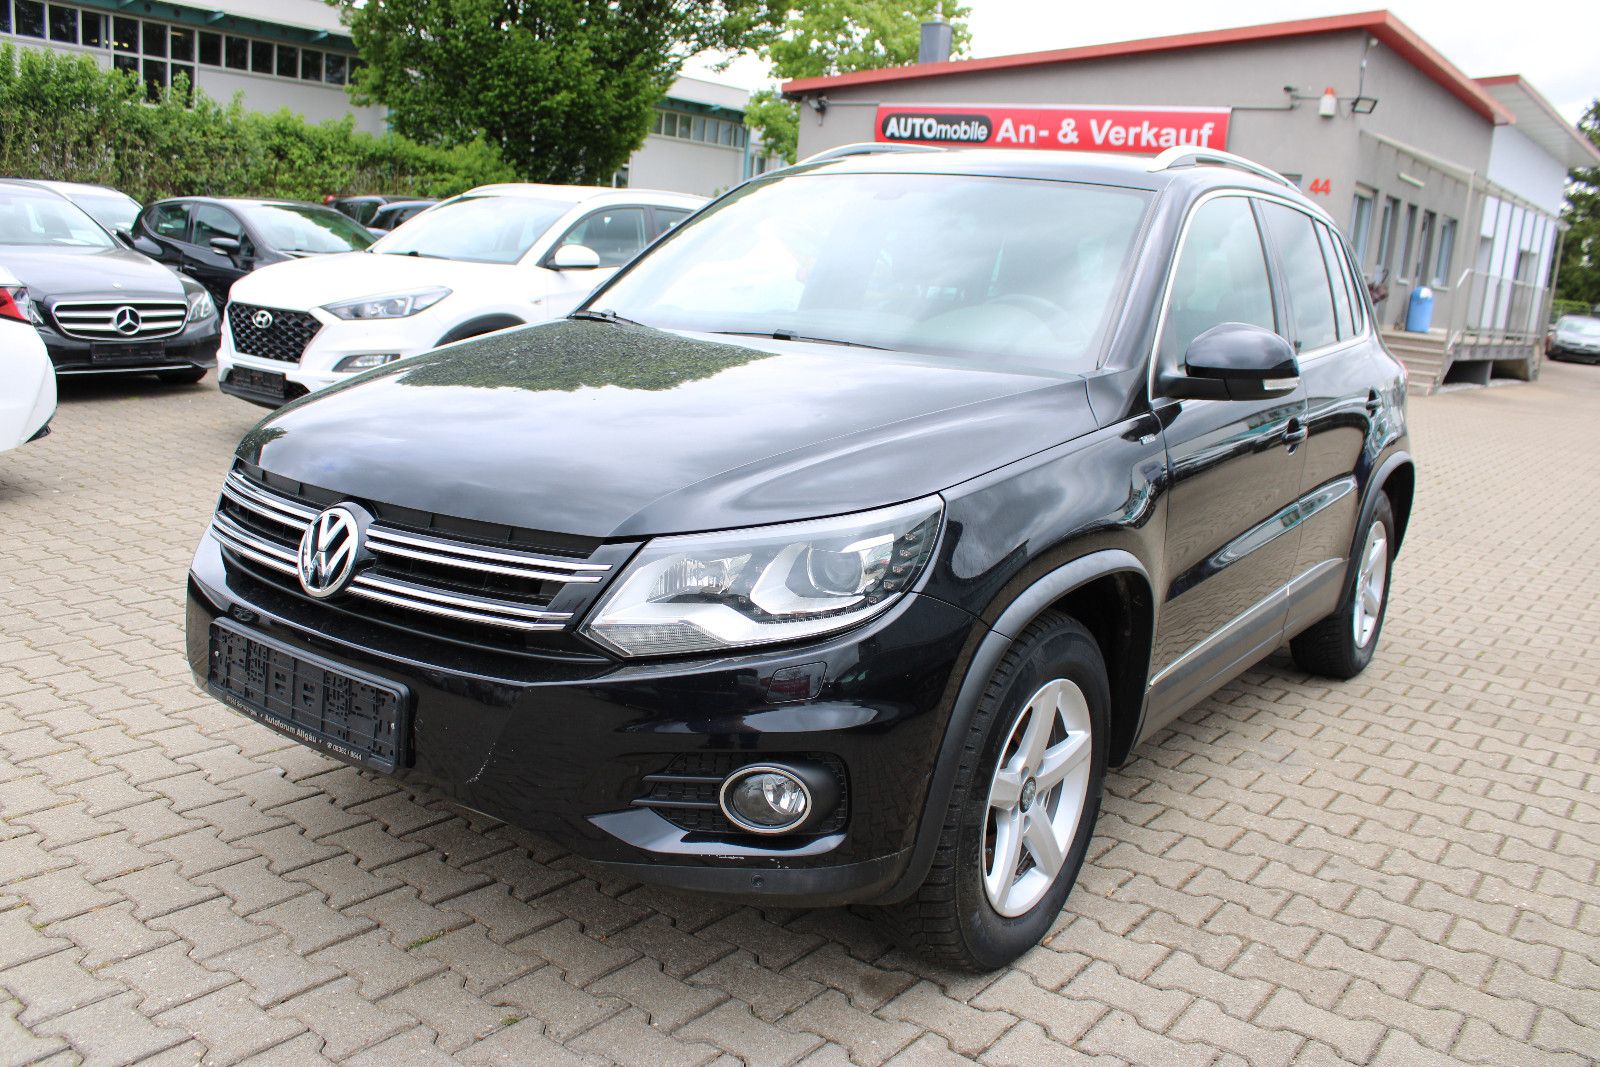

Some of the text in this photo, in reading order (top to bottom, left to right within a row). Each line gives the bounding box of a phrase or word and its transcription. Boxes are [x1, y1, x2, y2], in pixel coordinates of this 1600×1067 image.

[884, 117, 1216, 148] AUTOmobile An- & Verkauf
[1309, 177, 1332, 197] 44
[264, 713, 297, 734] Autoforum
